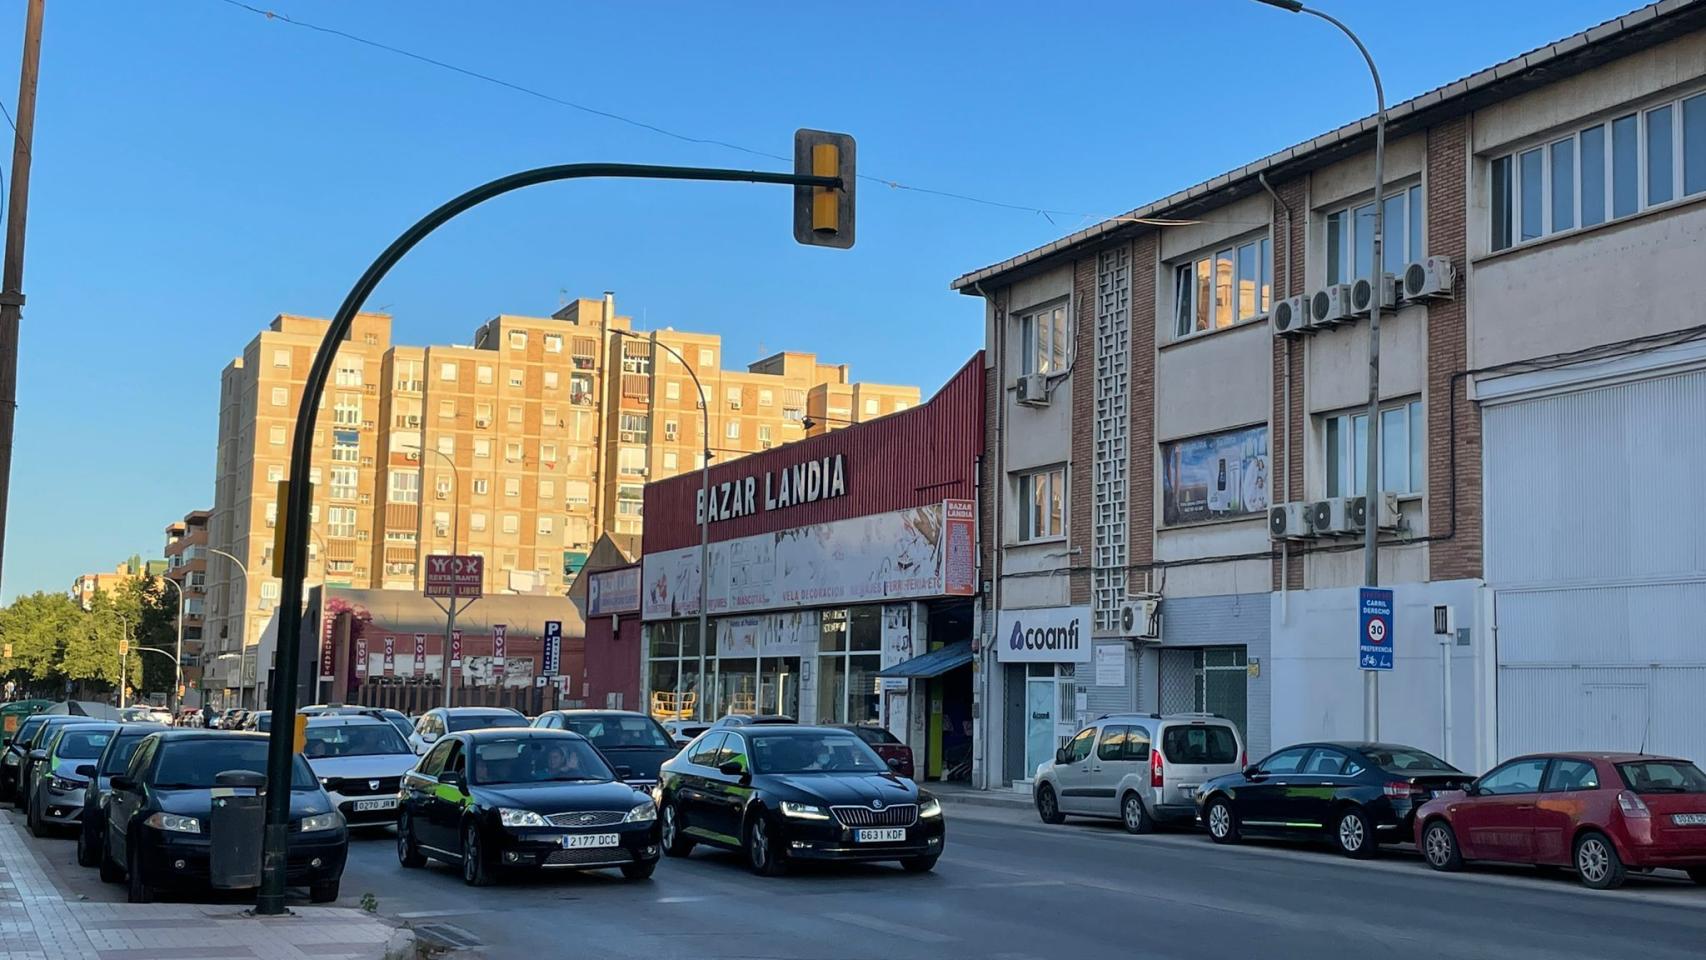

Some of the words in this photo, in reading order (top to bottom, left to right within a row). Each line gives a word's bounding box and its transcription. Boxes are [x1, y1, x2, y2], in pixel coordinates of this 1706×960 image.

[696, 476, 756, 526] BAZAR
[765, 453, 845, 511] LANDIA
[947, 510, 973, 518] LANDIA
[431, 558, 478, 574] WOK
[429, 586, 453, 595] BUFFE
[459, 586, 480, 596] LIBRE
[1366, 599, 1387, 608] CARRIL
[1363, 607, 1391, 616] DERECHO
[548, 622, 559, 635] P
[1025, 618, 1080, 650] coanfi
[1370, 625, 1383, 635] 30
[495, 627, 504, 657] WOK
[358, 641, 366, 665] WOK
[384, 638, 394, 663] WOK
[416, 636, 425, 662] WOK
[1360, 645, 1392, 653] PREFERENCIA
[359, 801, 379, 810] 0270
[570, 835, 595, 847] 2177
[598, 834, 617, 846] DCC
[861, 830, 884, 840] 6631
[886, 829, 903, 840] KDF
